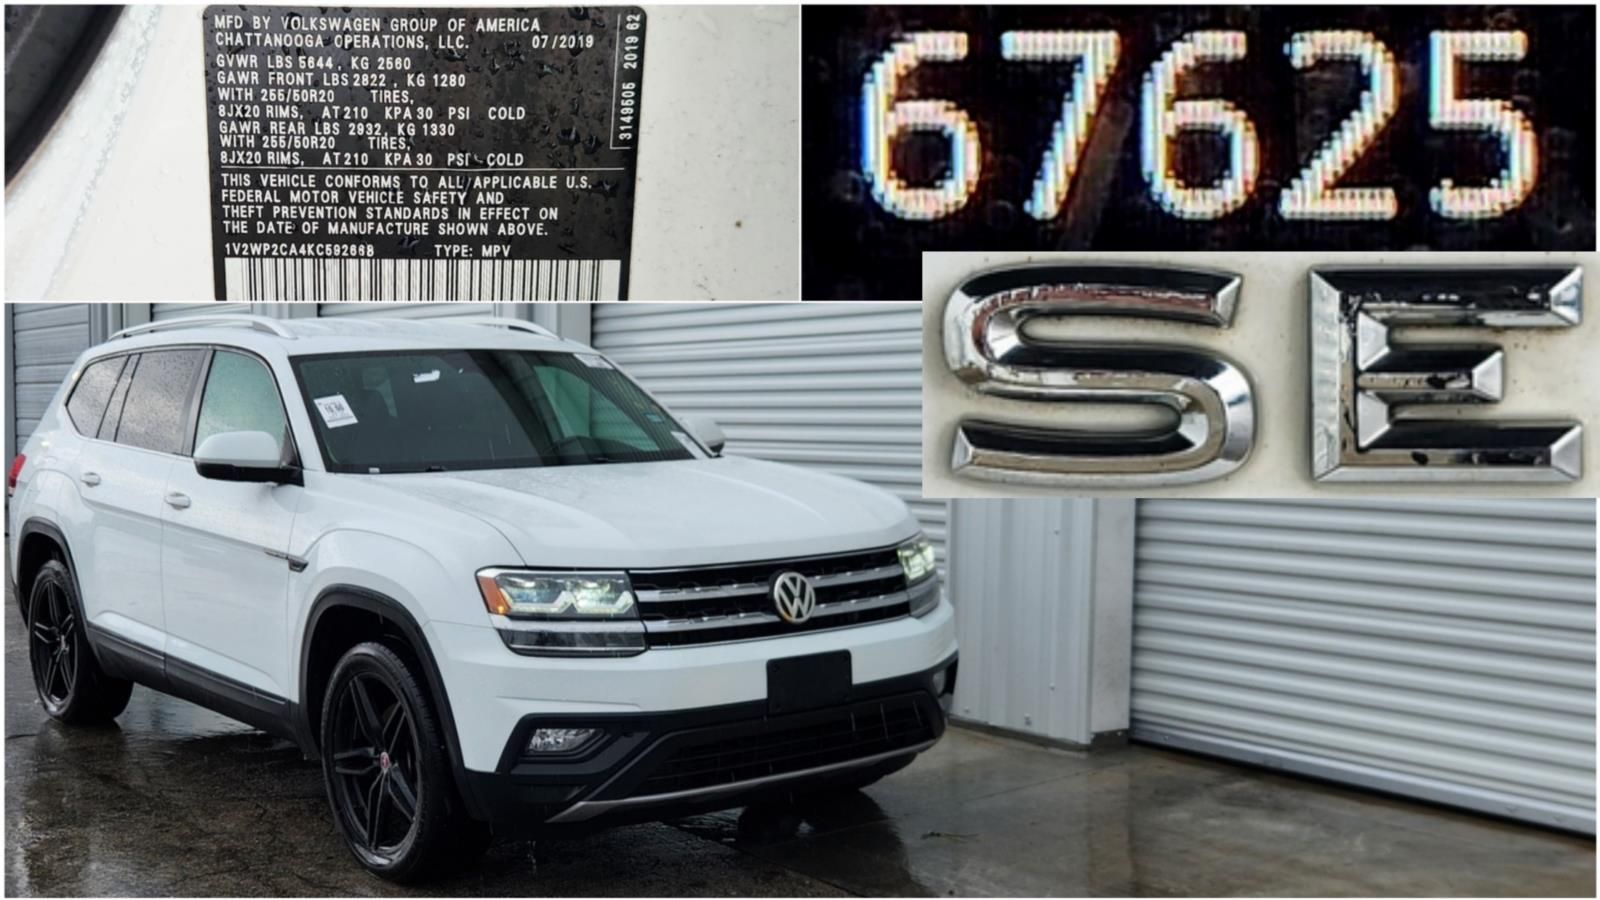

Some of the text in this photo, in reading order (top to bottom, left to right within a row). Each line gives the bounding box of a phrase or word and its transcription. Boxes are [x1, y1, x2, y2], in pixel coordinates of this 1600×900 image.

[214, 15, 541, 32] MFD BY VOLKSWAGEN GROUP OF AMERICA
[215, 32, 324, 48] CHATTANOOGA
[334, 34, 429, 50] OPERATIONS,
[438, 35, 469, 49] LLC.
[216, 54, 258, 69] GVWR
[267, 56, 293, 69] LBS
[351, 57, 370, 70] KG
[377, 57, 411, 70] 2560
[217, 71, 259, 85] GAWR
[268, 72, 314, 86] FRONT
[323, 73, 349, 87] LBS
[407, 74, 426, 87] KG
[432, 74, 466, 87] 1280
[619, 14, 641, 140] 3149505 2019 62
[217, 88, 414, 105] WITH 255/50R20 TIRES,
[218, 104, 526, 121] 8JX20 RIMS, AT 210 KPA 30 PSI COLD
[218, 121, 261, 135] GAWR
[270, 122, 306, 135] REAR
[314, 123, 340, 136] LBS
[397, 123, 416, 136] KG
[422, 123, 455, 136] 1330
[862, 30, 1540, 220] 67625
[219, 135, 411, 151] WITH 255/50R20 TIRES,
[220, 151, 524, 167] 8JX20 RIMS, AT 210 KPA 30 PSI COLD
[221, 173, 592, 189] THIS VEHICLE CONFORMS TO ALL APPLICABLE U.S.
[221, 189, 505, 206] FEDERAL MOTOR VEHICLE SAFETY AND
[222, 205, 559, 220] THEFT PREVENTION STANDARDS IN EFFECT ON
[223, 221, 548, 236] THE DATE OF MANUFACTURE SHOWN ABOVE.
[434, 244, 473, 257] TYPE:
[481, 245, 511, 257] MPV
[943, 261, 1584, 487] SE
